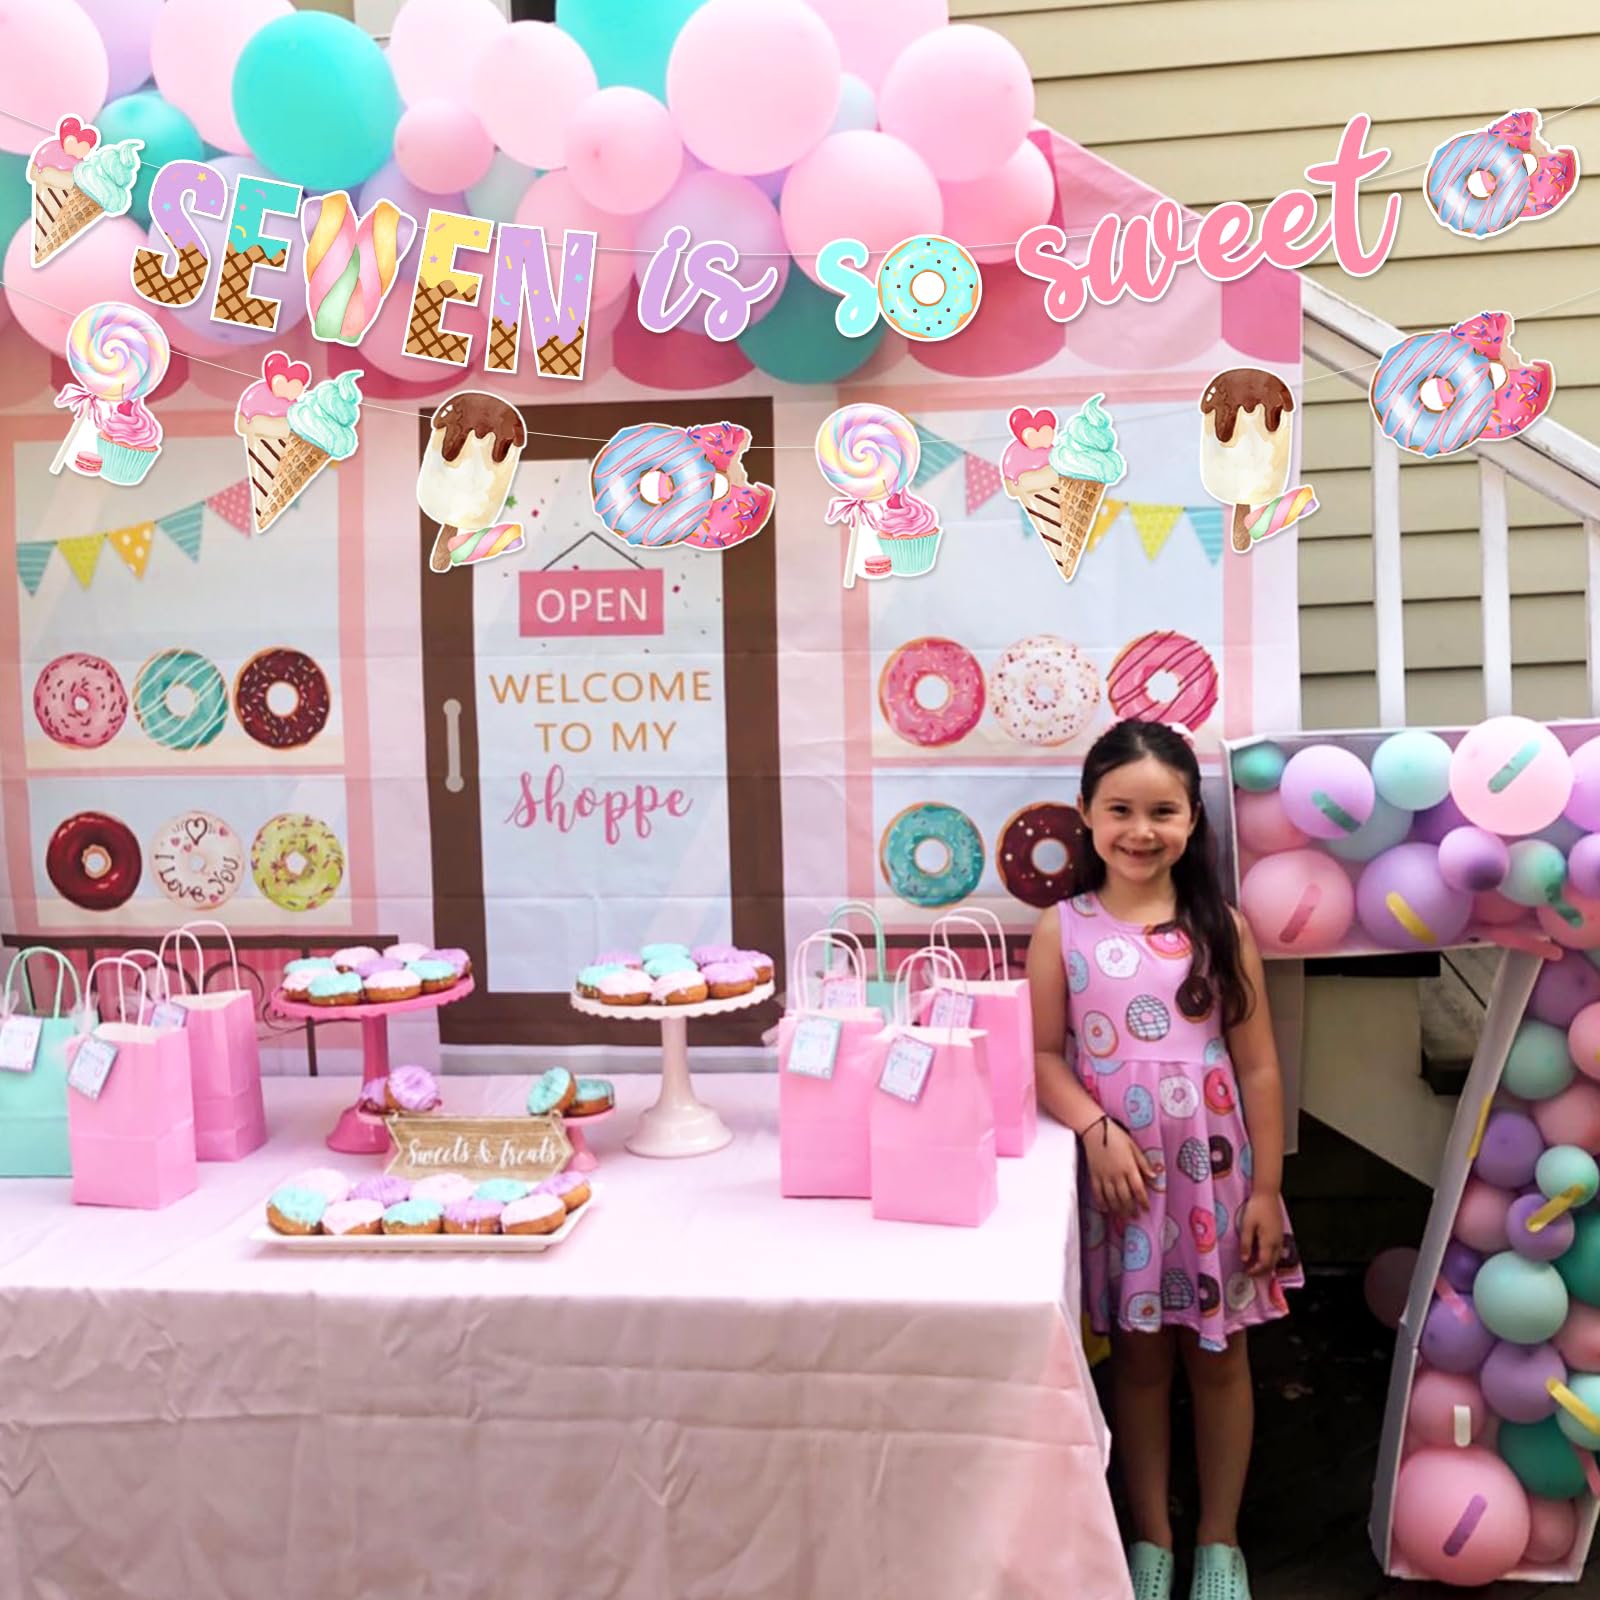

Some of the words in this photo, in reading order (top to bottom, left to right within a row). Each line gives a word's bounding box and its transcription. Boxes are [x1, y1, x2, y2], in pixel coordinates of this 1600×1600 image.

[131, 158, 597, 380] SEVEN
[637, 226, 778, 342] is
[1015, 112, 1401, 322] sweet
[535, 587, 648, 623] OPEN
[488, 671, 713, 704] WELCOME
[534, 721, 593, 752] TO
[612, 720, 677, 752] MY
[408, 1136, 470, 1168] Sweets
[474, 1138, 493, 1163] &
